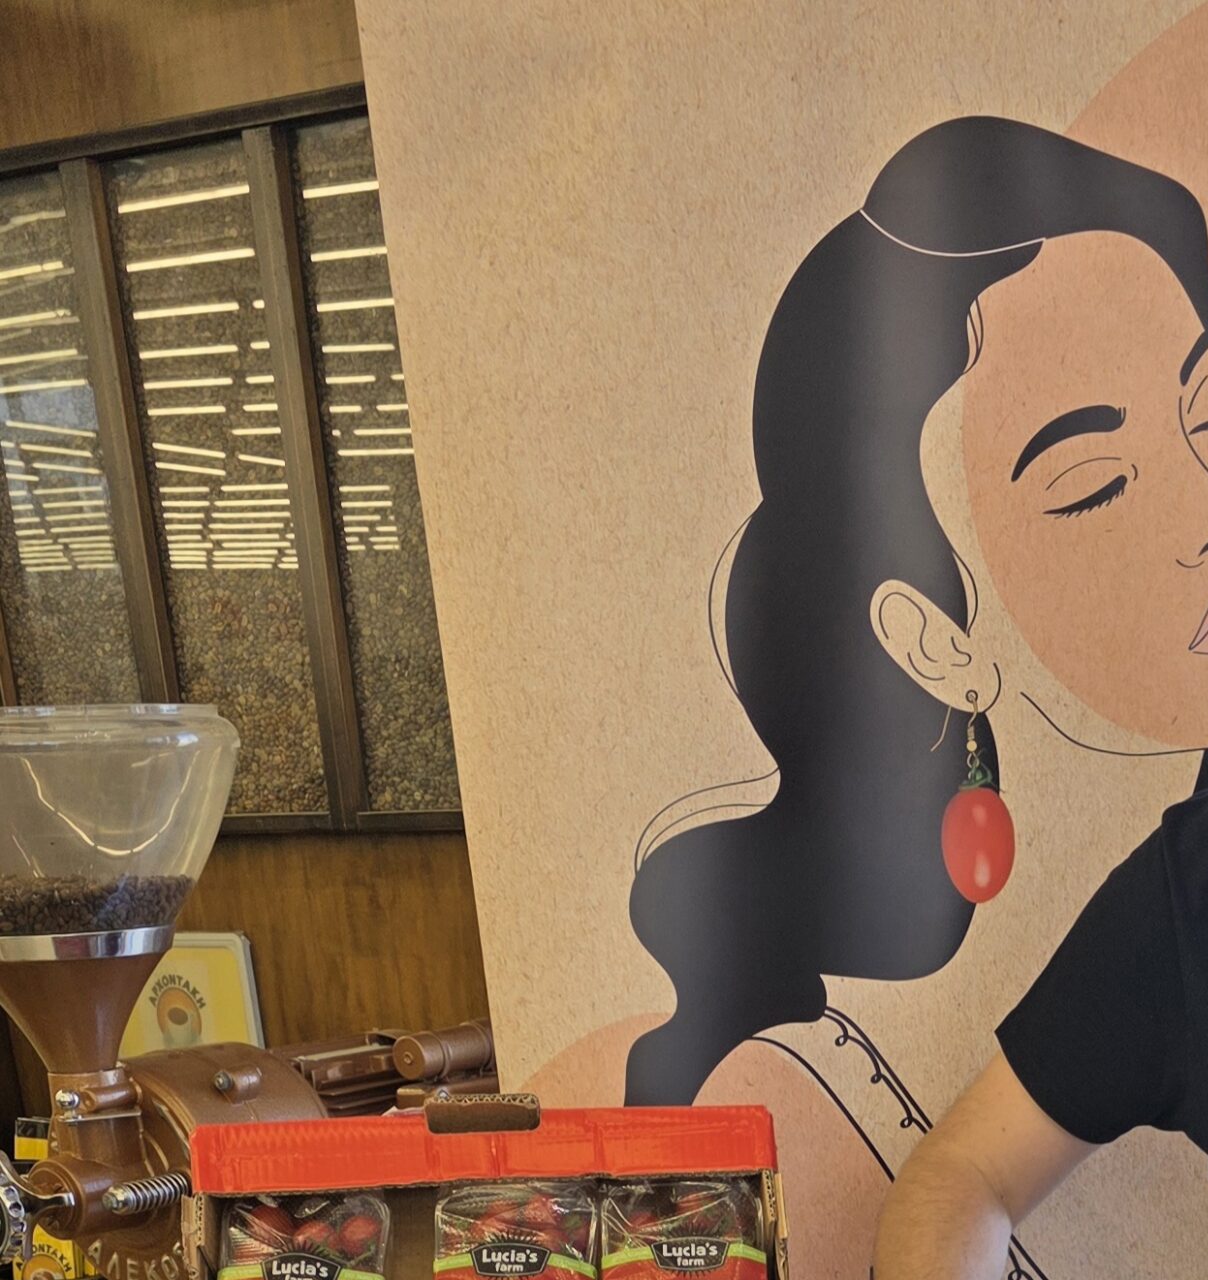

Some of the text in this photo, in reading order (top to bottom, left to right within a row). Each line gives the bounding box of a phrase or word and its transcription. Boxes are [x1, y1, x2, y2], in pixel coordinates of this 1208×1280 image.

[482, 1249, 538, 1264] Lucia's
[662, 1242, 718, 1259] Lucia's
[495, 1261, 524, 1273] farm
[677, 1255, 705, 1267] farm
[272, 1261, 329, 1278] Lucia's
